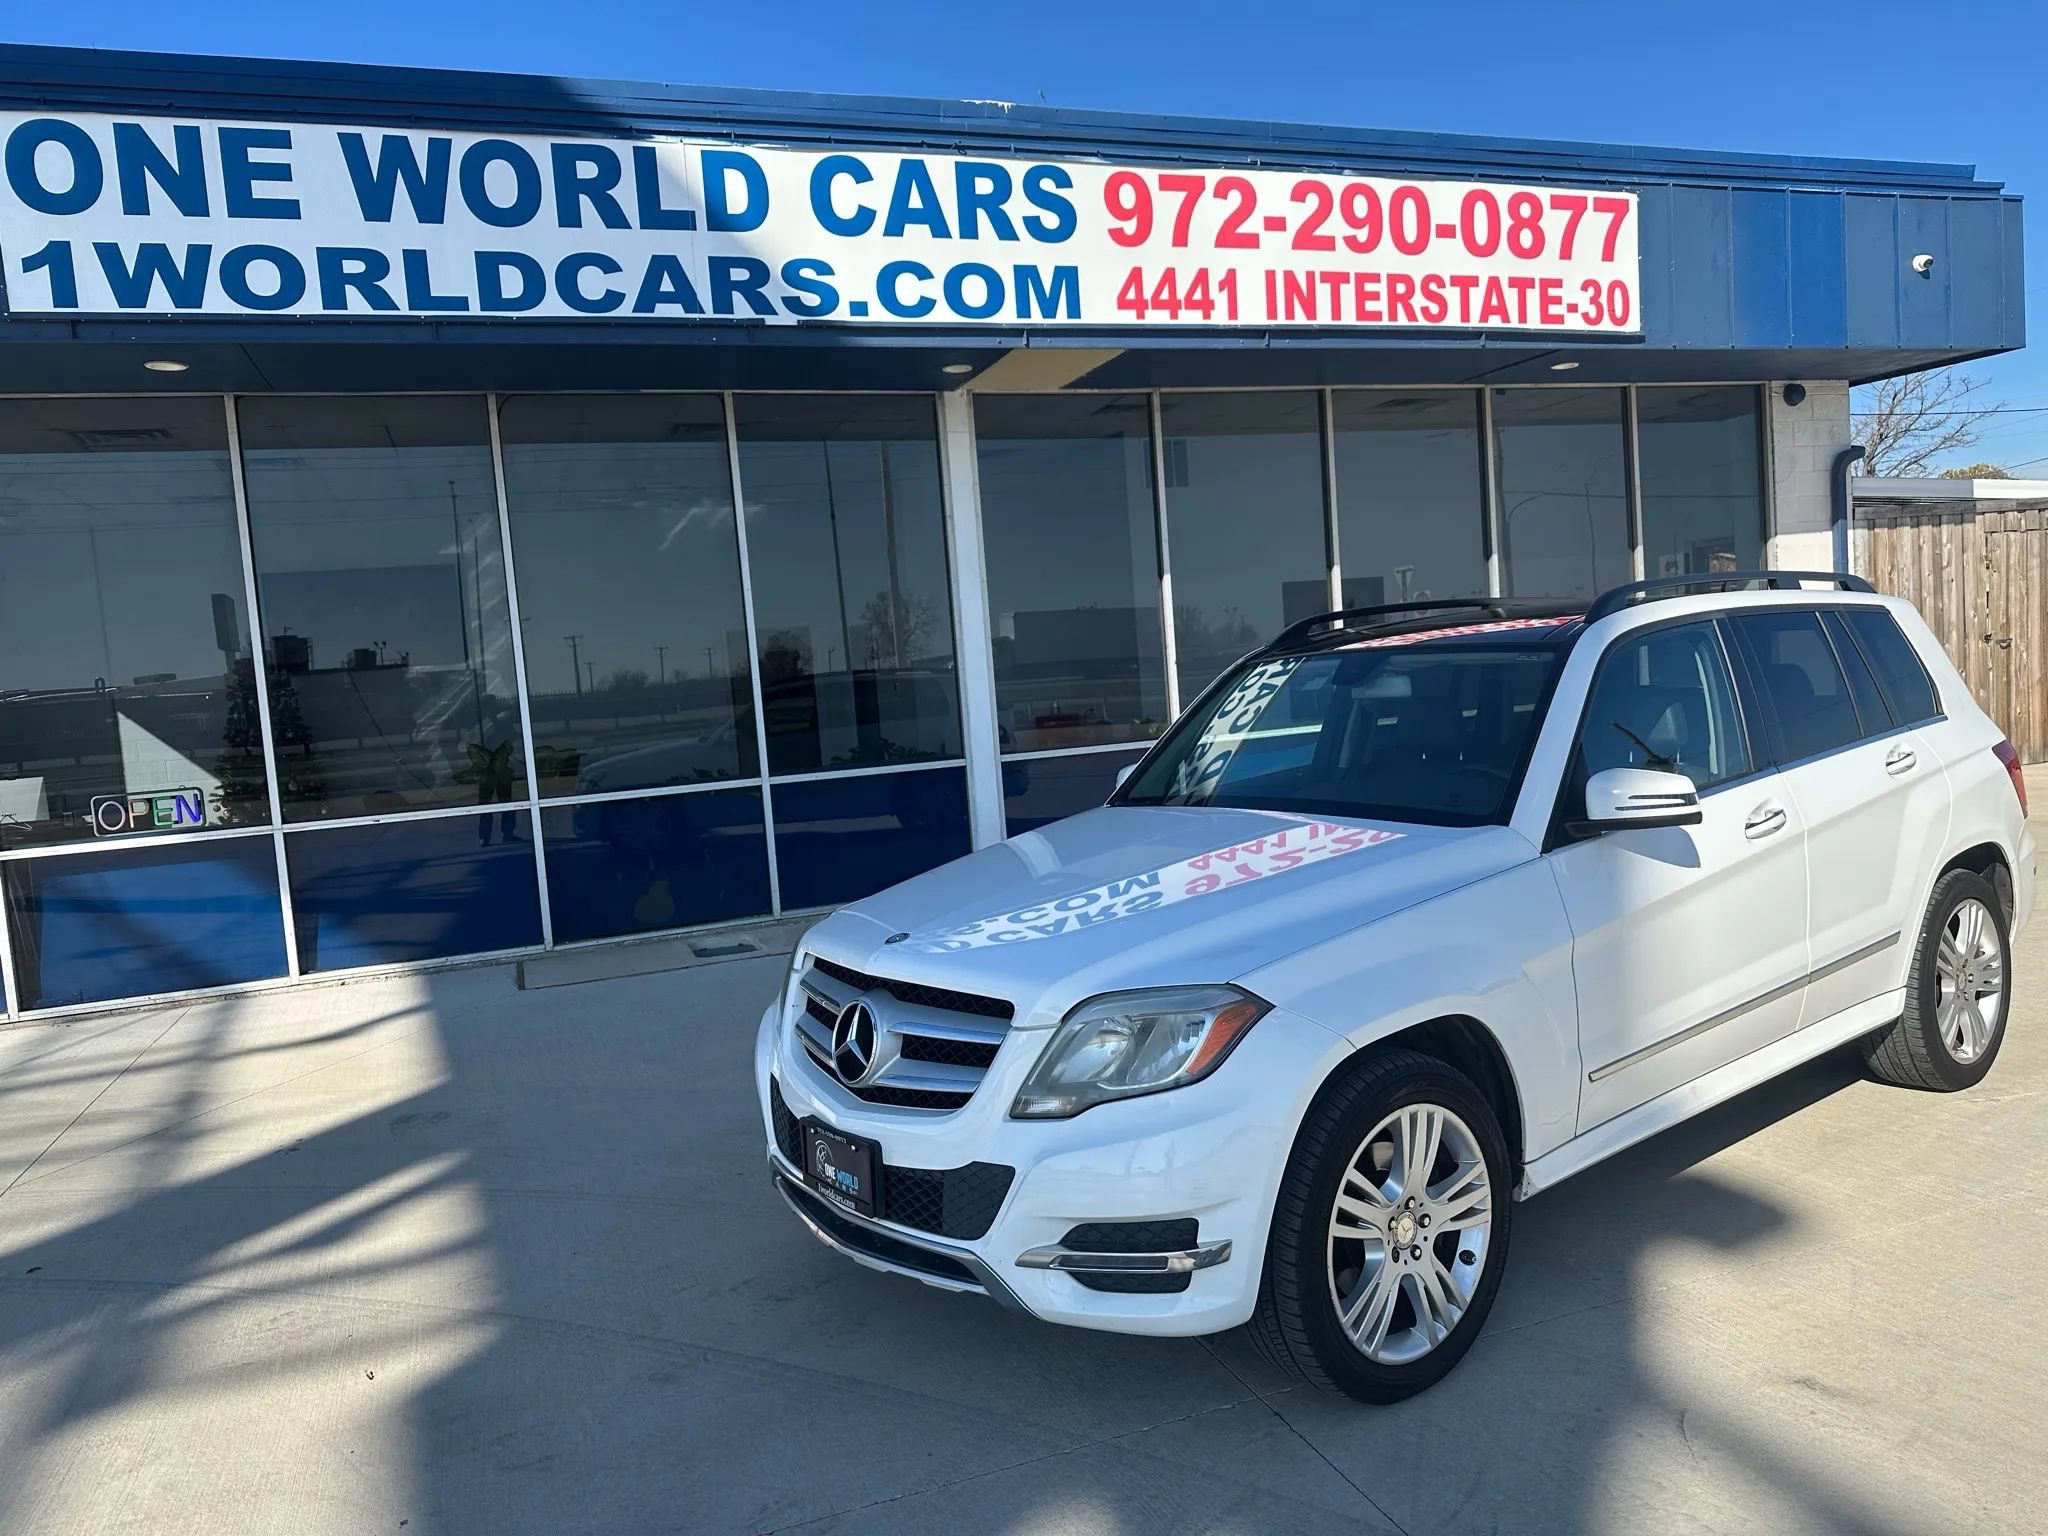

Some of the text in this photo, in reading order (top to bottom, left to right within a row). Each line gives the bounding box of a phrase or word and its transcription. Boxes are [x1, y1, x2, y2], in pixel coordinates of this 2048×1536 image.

[4, 117, 1077, 243] ONE WORLD CARS
[1103, 171, 1631, 262] 972-290-0877
[21, 240, 1081, 322] 1WORLDCARS.COM
[1117, 266, 1631, 327] 4441 INTERSTATE-30
[98, 793, 202, 831] OPEN
[824, 1162, 859, 1190] ONE WORLD
